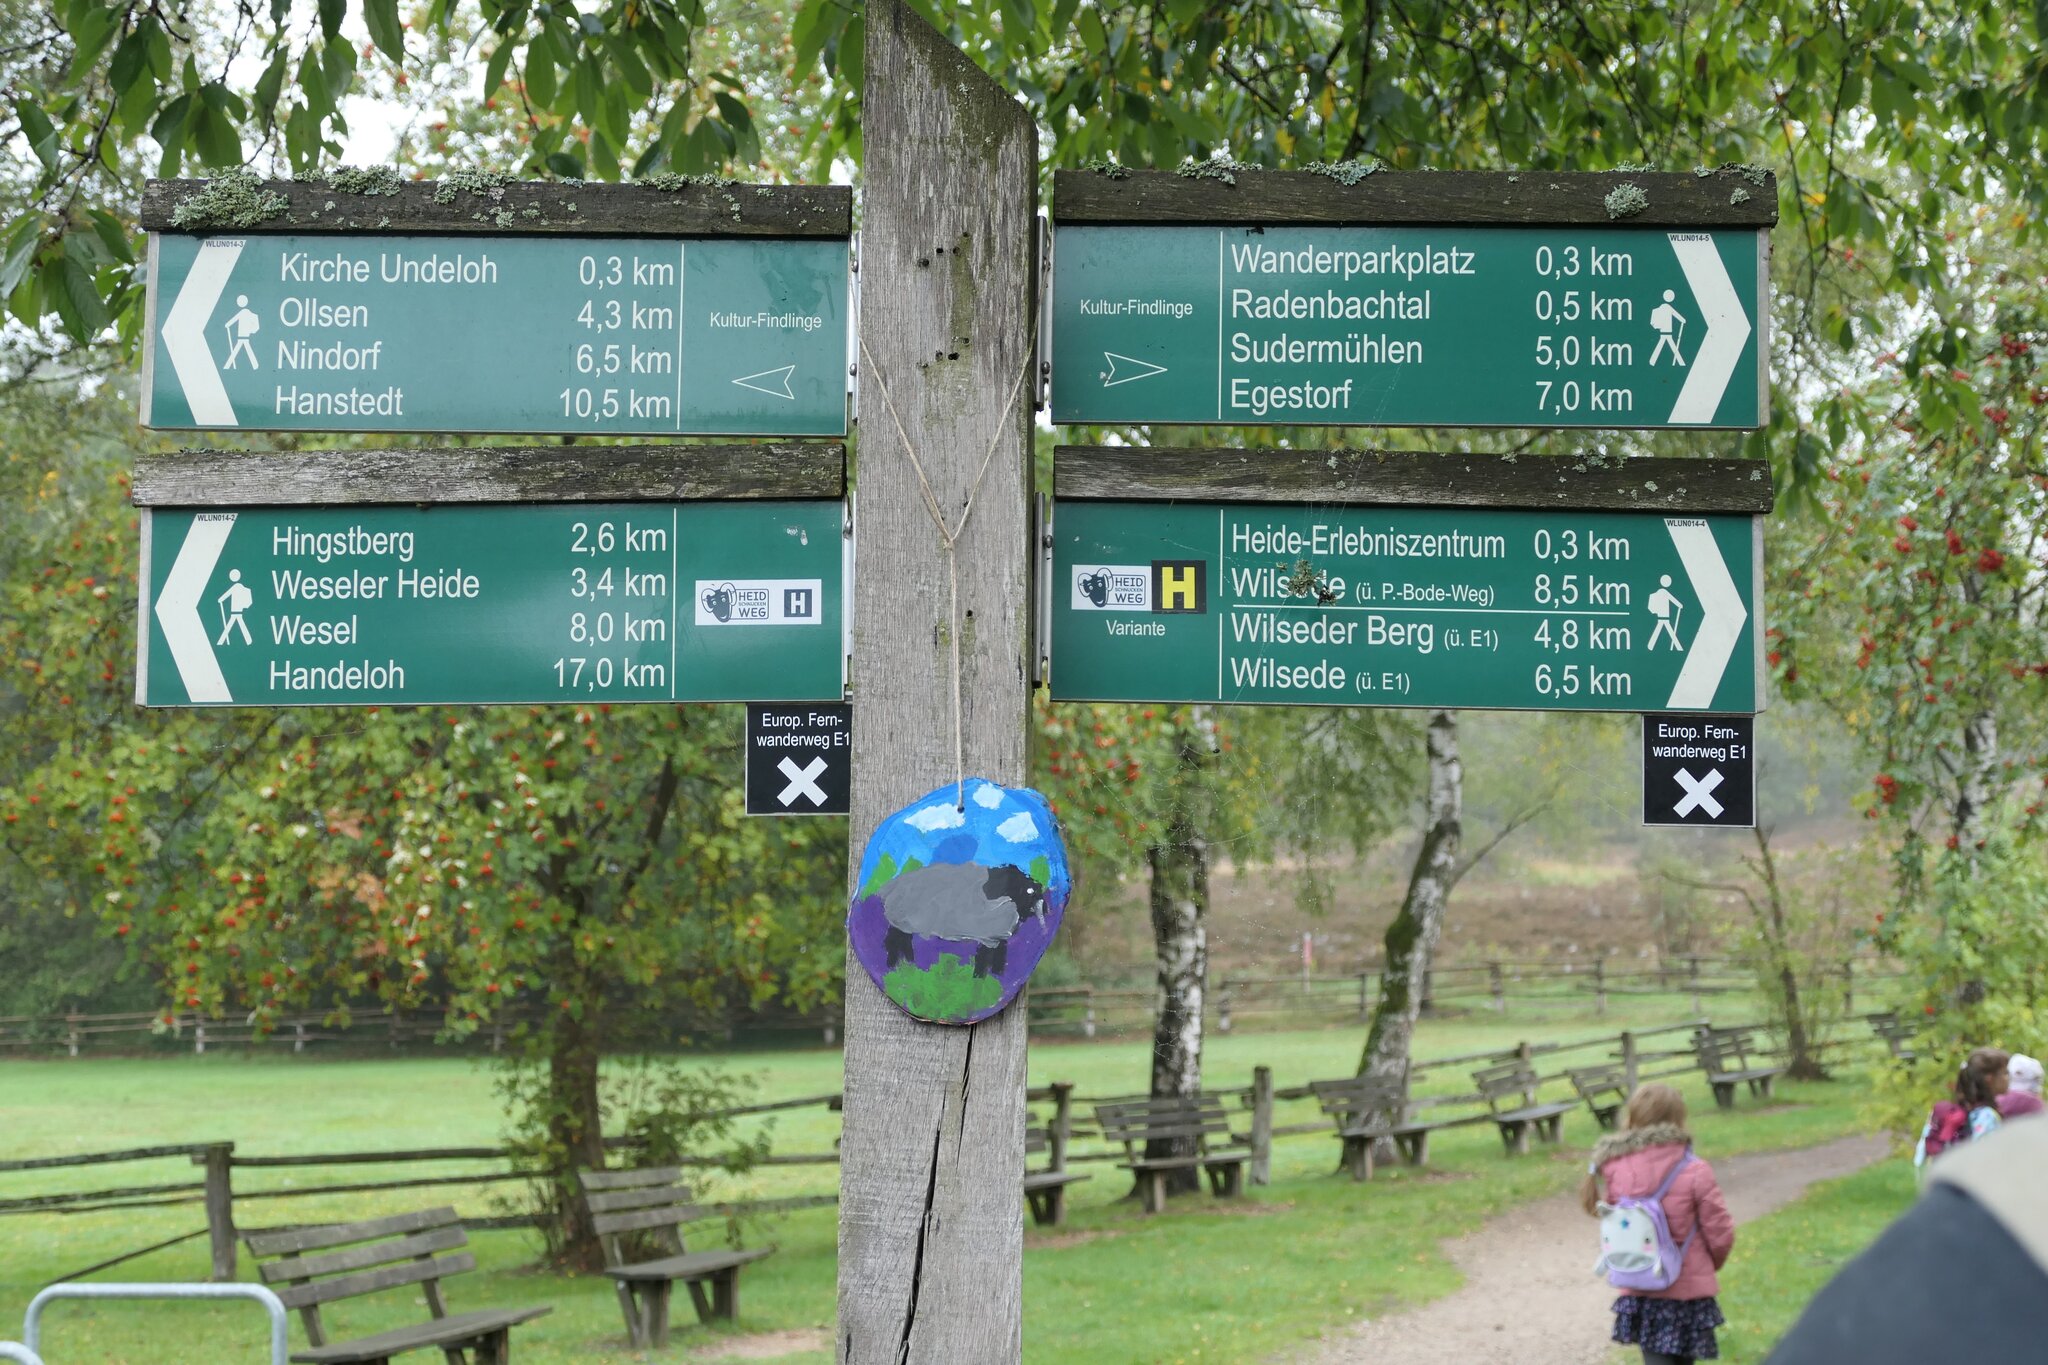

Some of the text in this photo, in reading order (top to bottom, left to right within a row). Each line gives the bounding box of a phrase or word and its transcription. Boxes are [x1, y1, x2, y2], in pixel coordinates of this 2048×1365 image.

[205, 240, 244, 248] WLUN014-3
[1670, 234, 1710, 242] WLUN014-5
[282, 253, 673, 289] Kirche Undeloh 0,3 km
[1231, 244, 1632, 280] Wanderparkplatz 0,3 km
[280, 298, 672, 333] Ollsen 4,3 km
[710, 312, 821, 332] Kultur-Findlinge
[1081, 299, 1192, 318] Kultur-Findlinge
[1233, 289, 1632, 325] Radenbachtal 0,5 km
[278, 341, 671, 377] Nindorf 6,5 km
[1231, 333, 1632, 370] Sudermühlen 5,0 km
[276, 386, 670, 422] Hanstedt 10,5 km
[1232, 379, 1632, 415] Egestorf 7,0 km
[197, 514, 236, 522] WLUN014-2
[1666, 519, 1706, 528] WLUN014-4
[274, 522, 666, 562] Hingstberg 2,6 km
[1233, 524, 1629, 563] Heide-Erlebniszentrum 0,3 km
[272, 567, 665, 601] Weseler Heide 3,4 km
[738, 591, 767, 601] HEID
[1115, 577, 1143, 587] HEID
[1115, 593, 1143, 604] WEG
[1161, 566, 1196, 609] H
[1232, 567, 1629, 608] Wilsde (ü. P.-Bode-Weg) 8,5 km
[738, 607, 767, 618] WEG
[790, 591, 806, 614] H
[271, 612, 665, 646] Wesel 8,0 km
[1106, 620, 1165, 636] Variante
[1231, 613, 1630, 653] Wilseder Berg (ü. E1) 4,8 km
[270, 658, 664, 691] Handeloh 17,0 km
[1231, 658, 1631, 698] Wilsede (ü. E1) 6,5 km
[763, 713, 842, 729] Europ. Fern-
[1659, 724, 1738, 741] Europ. Fern-
[757, 732, 849, 749] wanderweg E1
[1653, 744, 1745, 761] wanderweg E1
